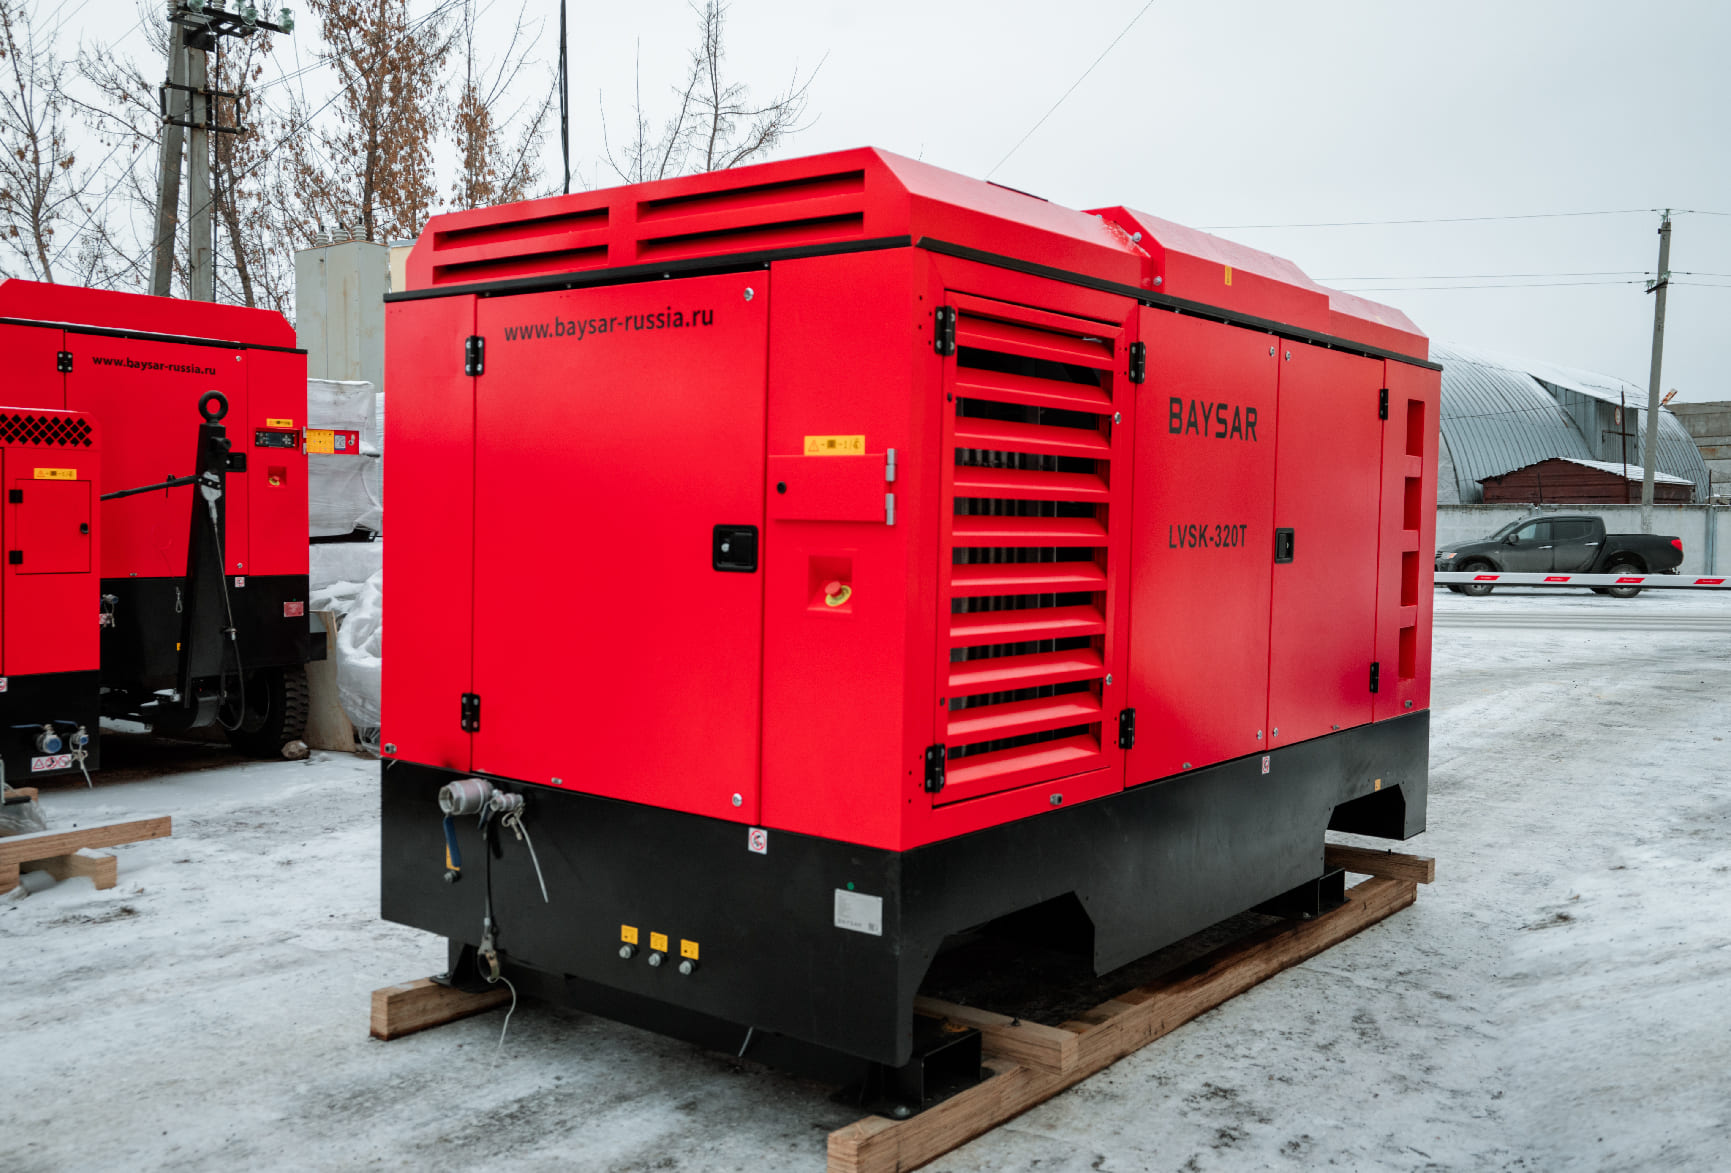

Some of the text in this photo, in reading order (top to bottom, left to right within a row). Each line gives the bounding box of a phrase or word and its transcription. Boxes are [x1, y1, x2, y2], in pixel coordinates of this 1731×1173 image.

[504, 306, 714, 341] www.baysar-russia.ru
[92, 356, 216, 375] www.baysar-russia.ru
[1169, 397, 1258, 442] BAYSAR
[1169, 524, 1248, 549] LVSK-320T
